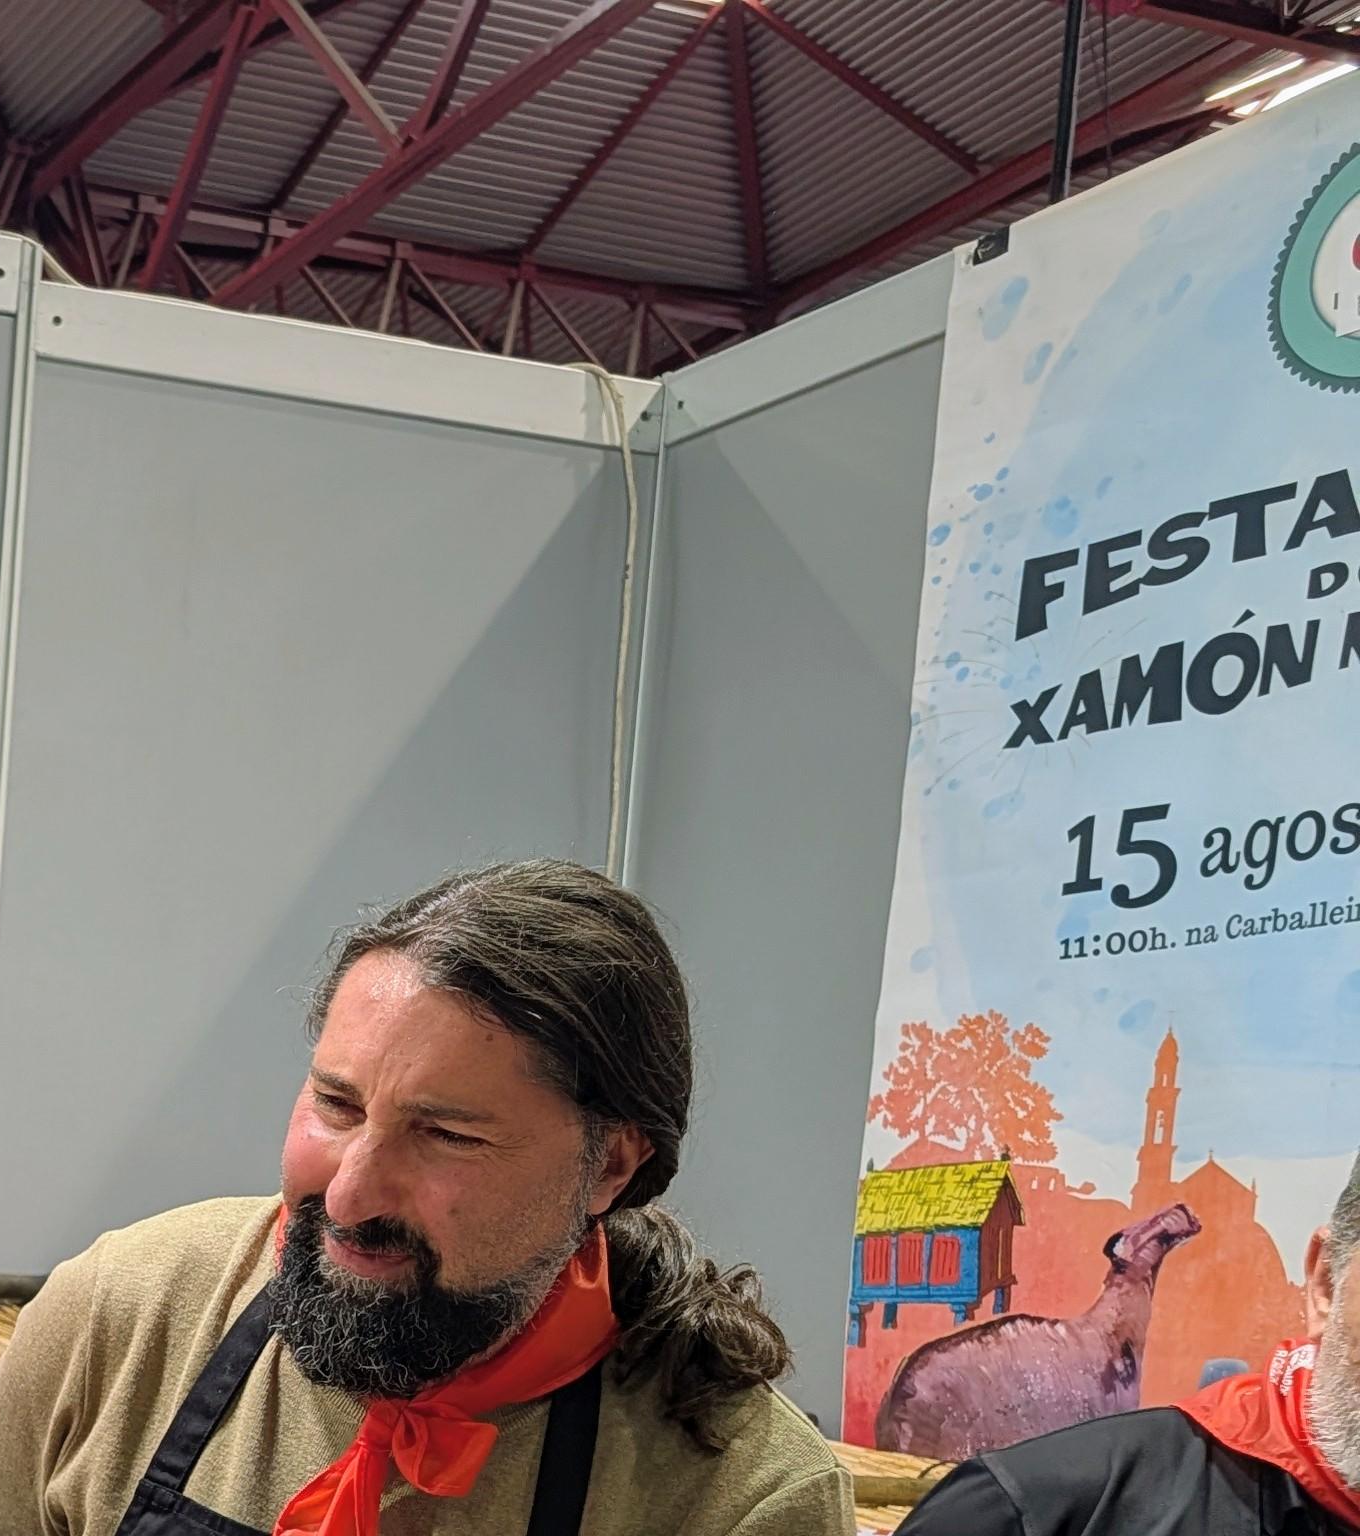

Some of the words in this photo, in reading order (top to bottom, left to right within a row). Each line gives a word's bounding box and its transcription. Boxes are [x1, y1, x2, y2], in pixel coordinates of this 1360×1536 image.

[1307, 561, 1360, 600] D
[1002, 609, 1321, 749] XAMÓN
[1061, 803, 1178, 909] 15
[1184, 925, 1218, 947] na
